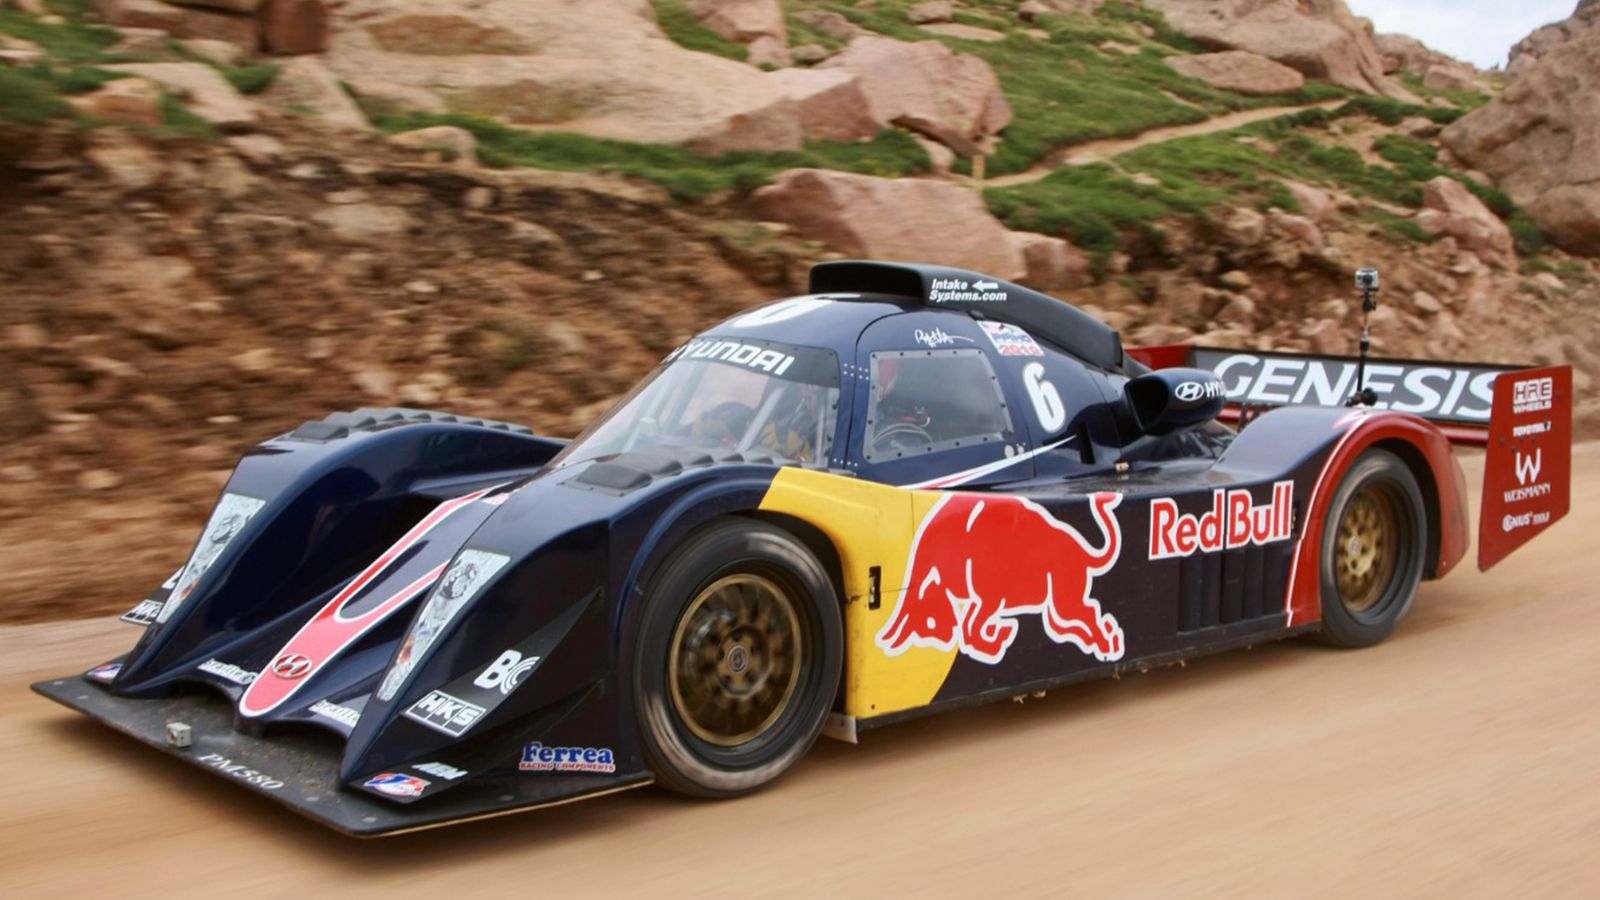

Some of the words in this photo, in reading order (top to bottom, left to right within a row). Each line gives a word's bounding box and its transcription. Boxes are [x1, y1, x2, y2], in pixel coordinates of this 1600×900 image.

[929, 289, 1008, 303] Systems.com
[931, 278, 968, 290] Intake
[660, 341, 795, 375] HYUNDAI
[1023, 361, 1066, 433] 6
[1212, 354, 1496, 420] GENESIS
[1513, 376, 1553, 405] HRE
[1513, 400, 1553, 415] WHEELS
[1504, 482, 1551, 503] WEISMANN
[1149, 488, 1226, 560] Red
[1226, 480, 1294, 549] Bull
[414, 692, 482, 730] HKS
[519, 762, 554, 771] RACING
[555, 762, 616, 773] COMPONENTS
[521, 742, 614, 765] Ferrea
[197, 753, 285, 790] PM580
